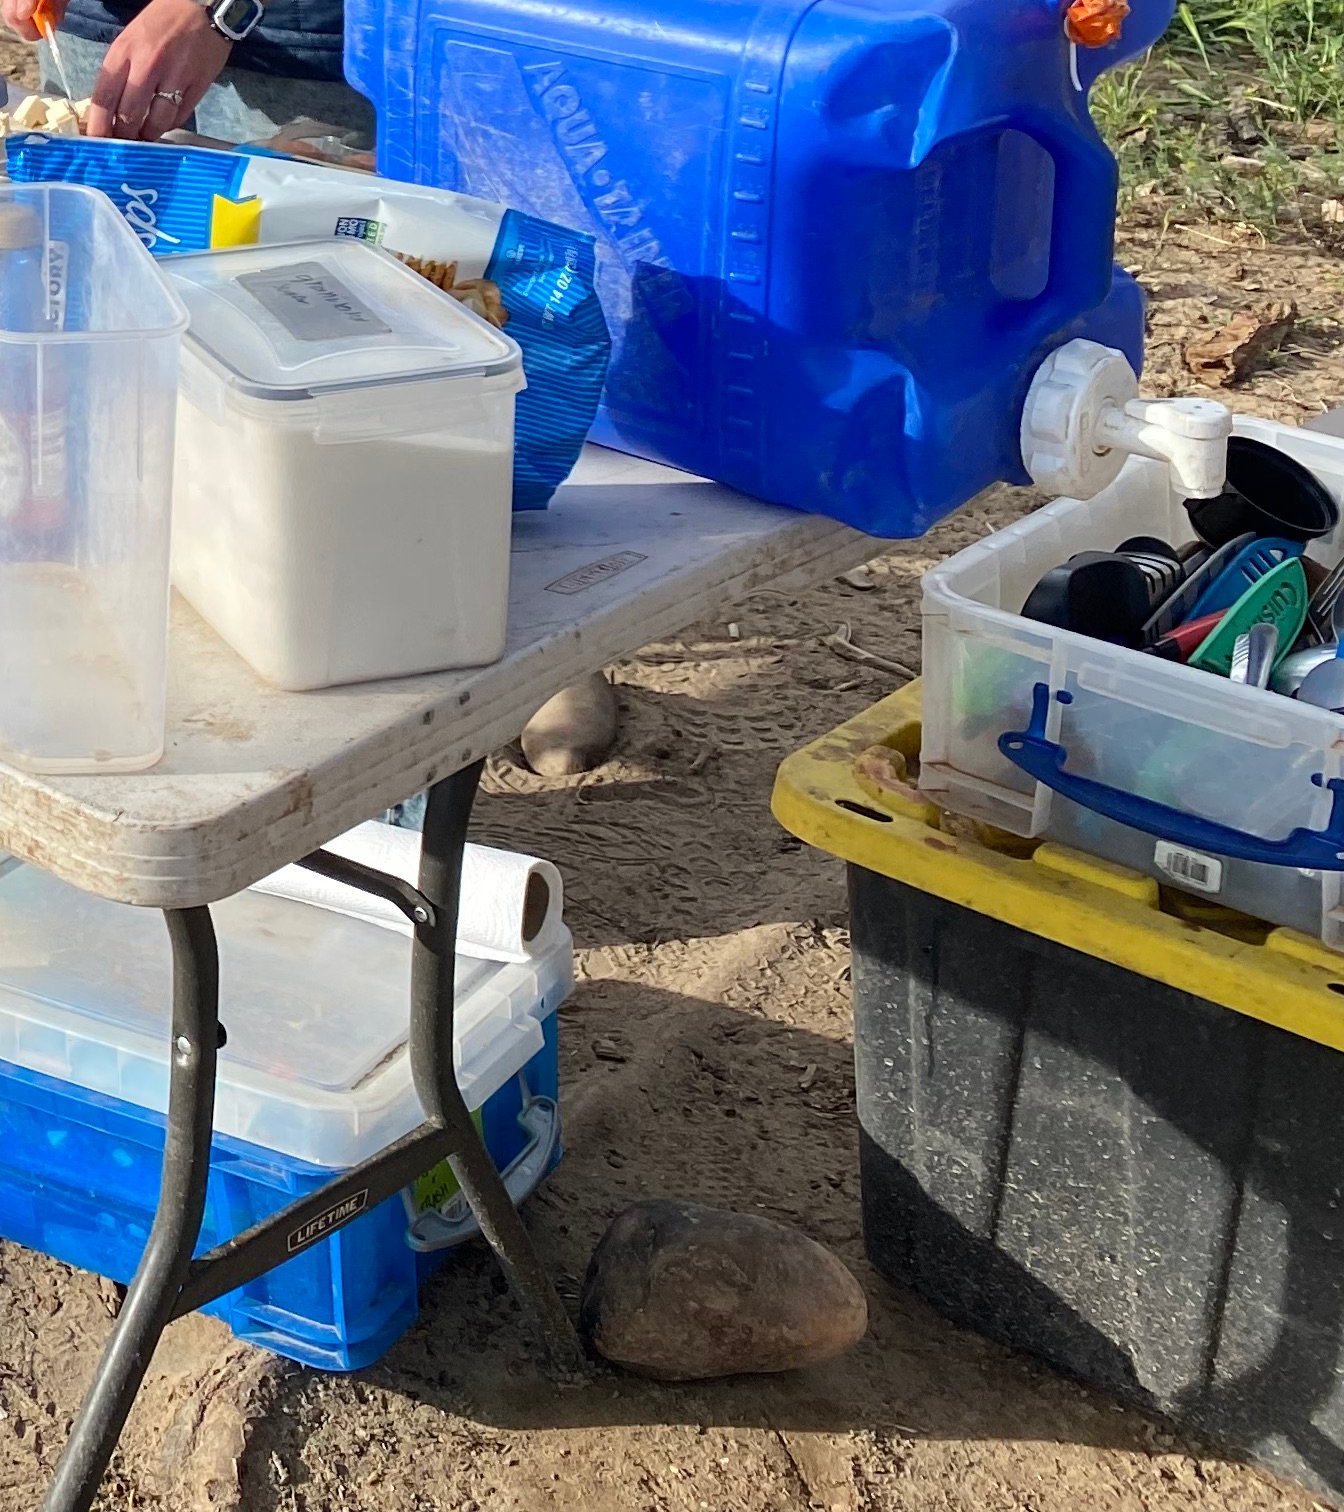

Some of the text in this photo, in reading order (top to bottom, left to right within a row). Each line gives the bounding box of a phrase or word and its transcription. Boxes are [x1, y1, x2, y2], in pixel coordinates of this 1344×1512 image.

[549, 289, 564, 305] 14
[556, 272, 572, 291] OZ
[1254, 582, 1297, 625] Cuis
[296, 1197, 359, 1244] LIFETIME
